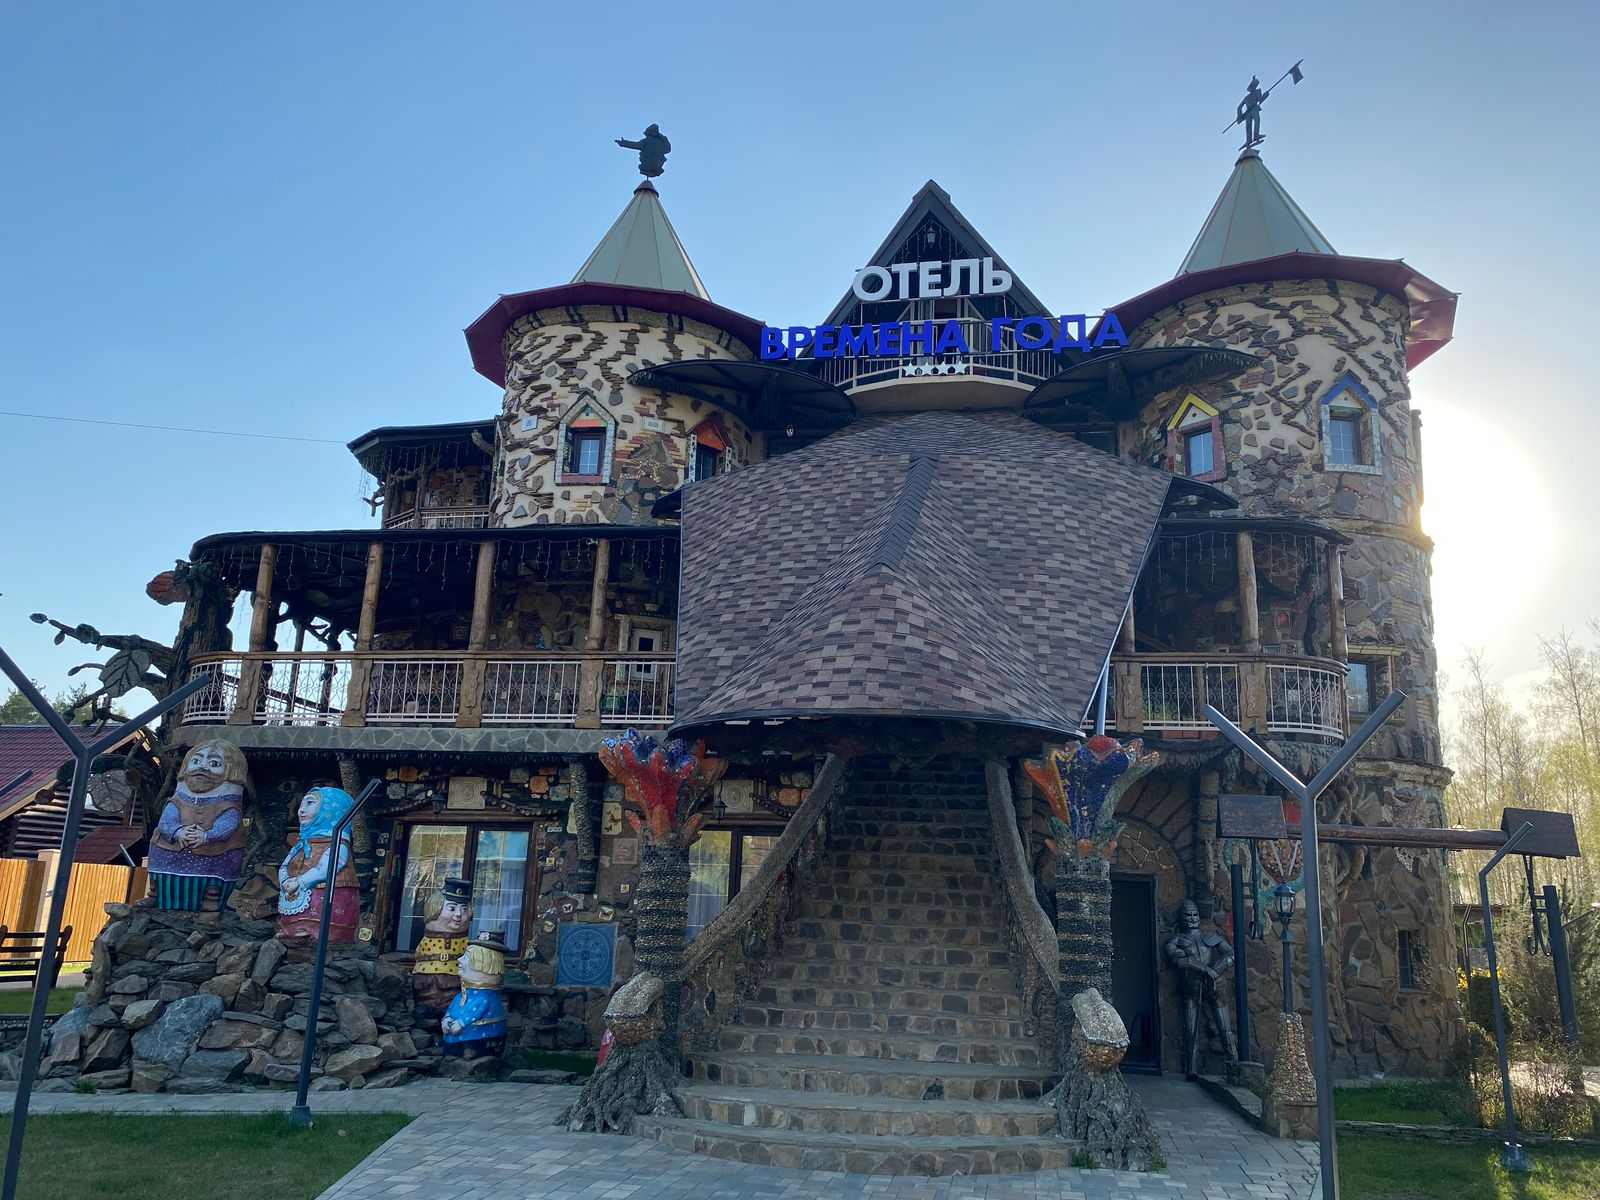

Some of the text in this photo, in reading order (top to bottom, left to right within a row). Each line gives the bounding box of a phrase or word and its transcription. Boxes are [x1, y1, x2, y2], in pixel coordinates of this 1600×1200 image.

[852, 257, 1013, 301] ОТЕЛЬ
[760, 313, 1130, 360] ВРЕМЕНА ГОДА
